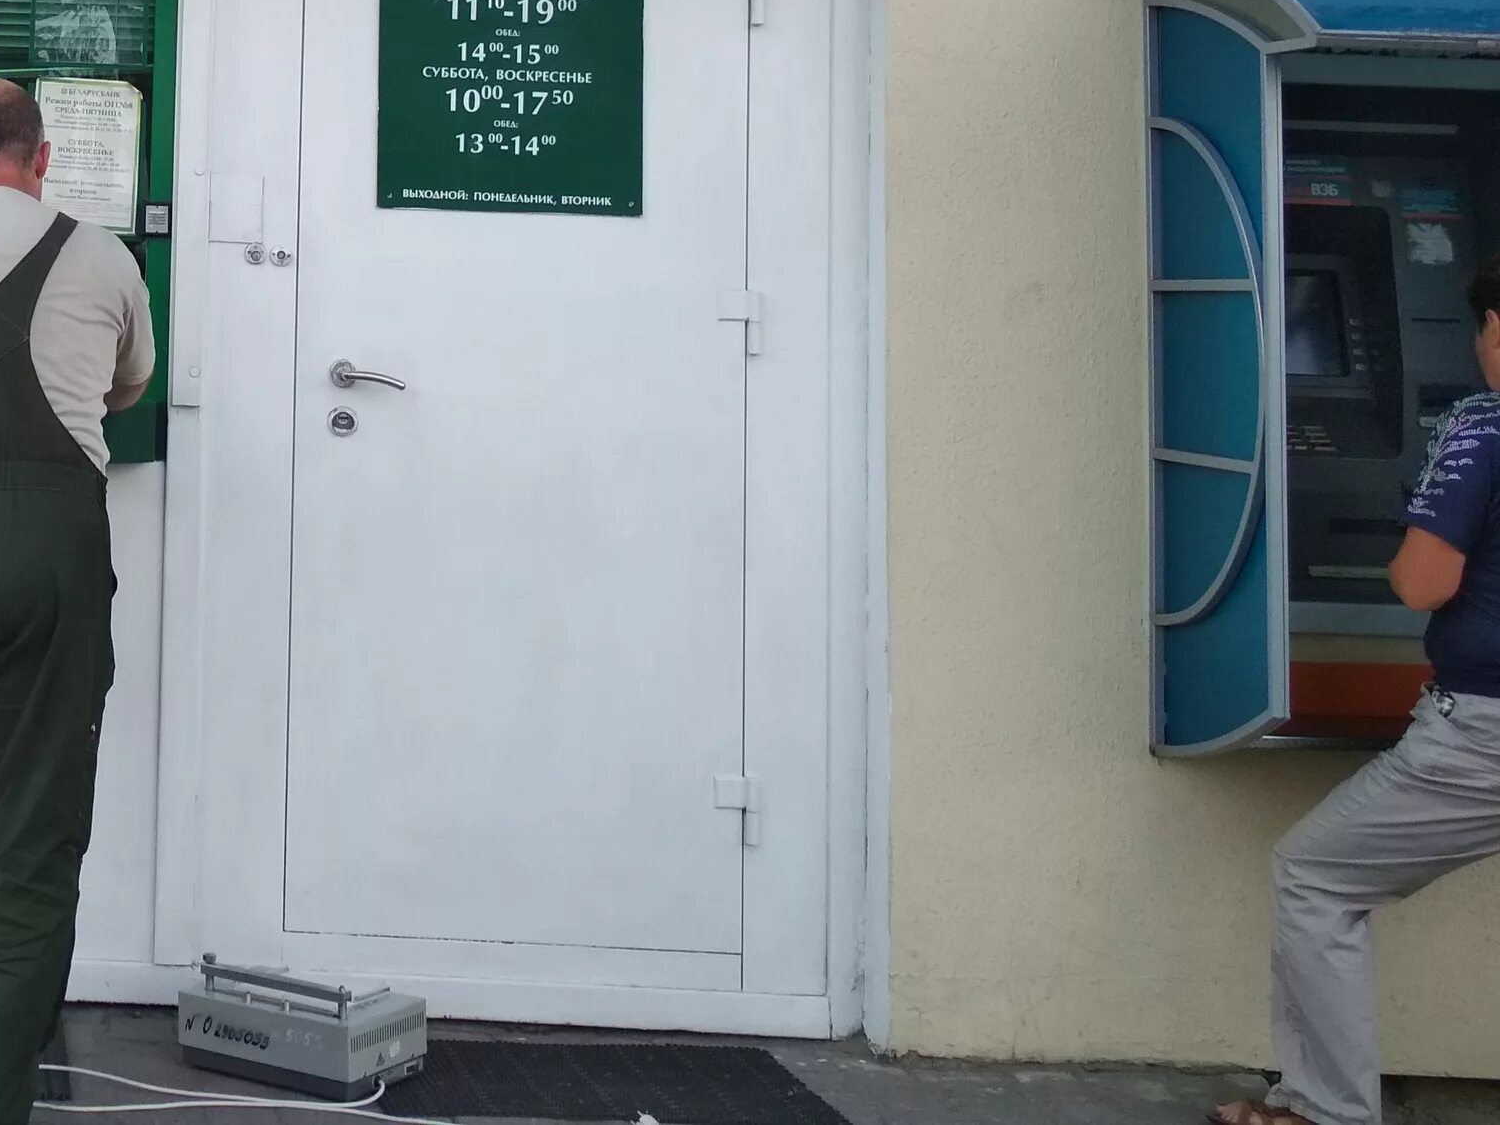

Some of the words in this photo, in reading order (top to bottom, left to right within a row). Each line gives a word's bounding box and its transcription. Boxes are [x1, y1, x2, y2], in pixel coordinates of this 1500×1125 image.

[422, 66, 489, 82] СУББОТА,
[496, 69, 593, 84] ВОСКРЕСЕНЬЕ
[402, 188, 469, 201] ВЫХОДНОЙ:
[473, 191, 557, 206] ПОНЕДЕЛЬНИК,
[561, 195, 612, 206] ВТОРНИК
